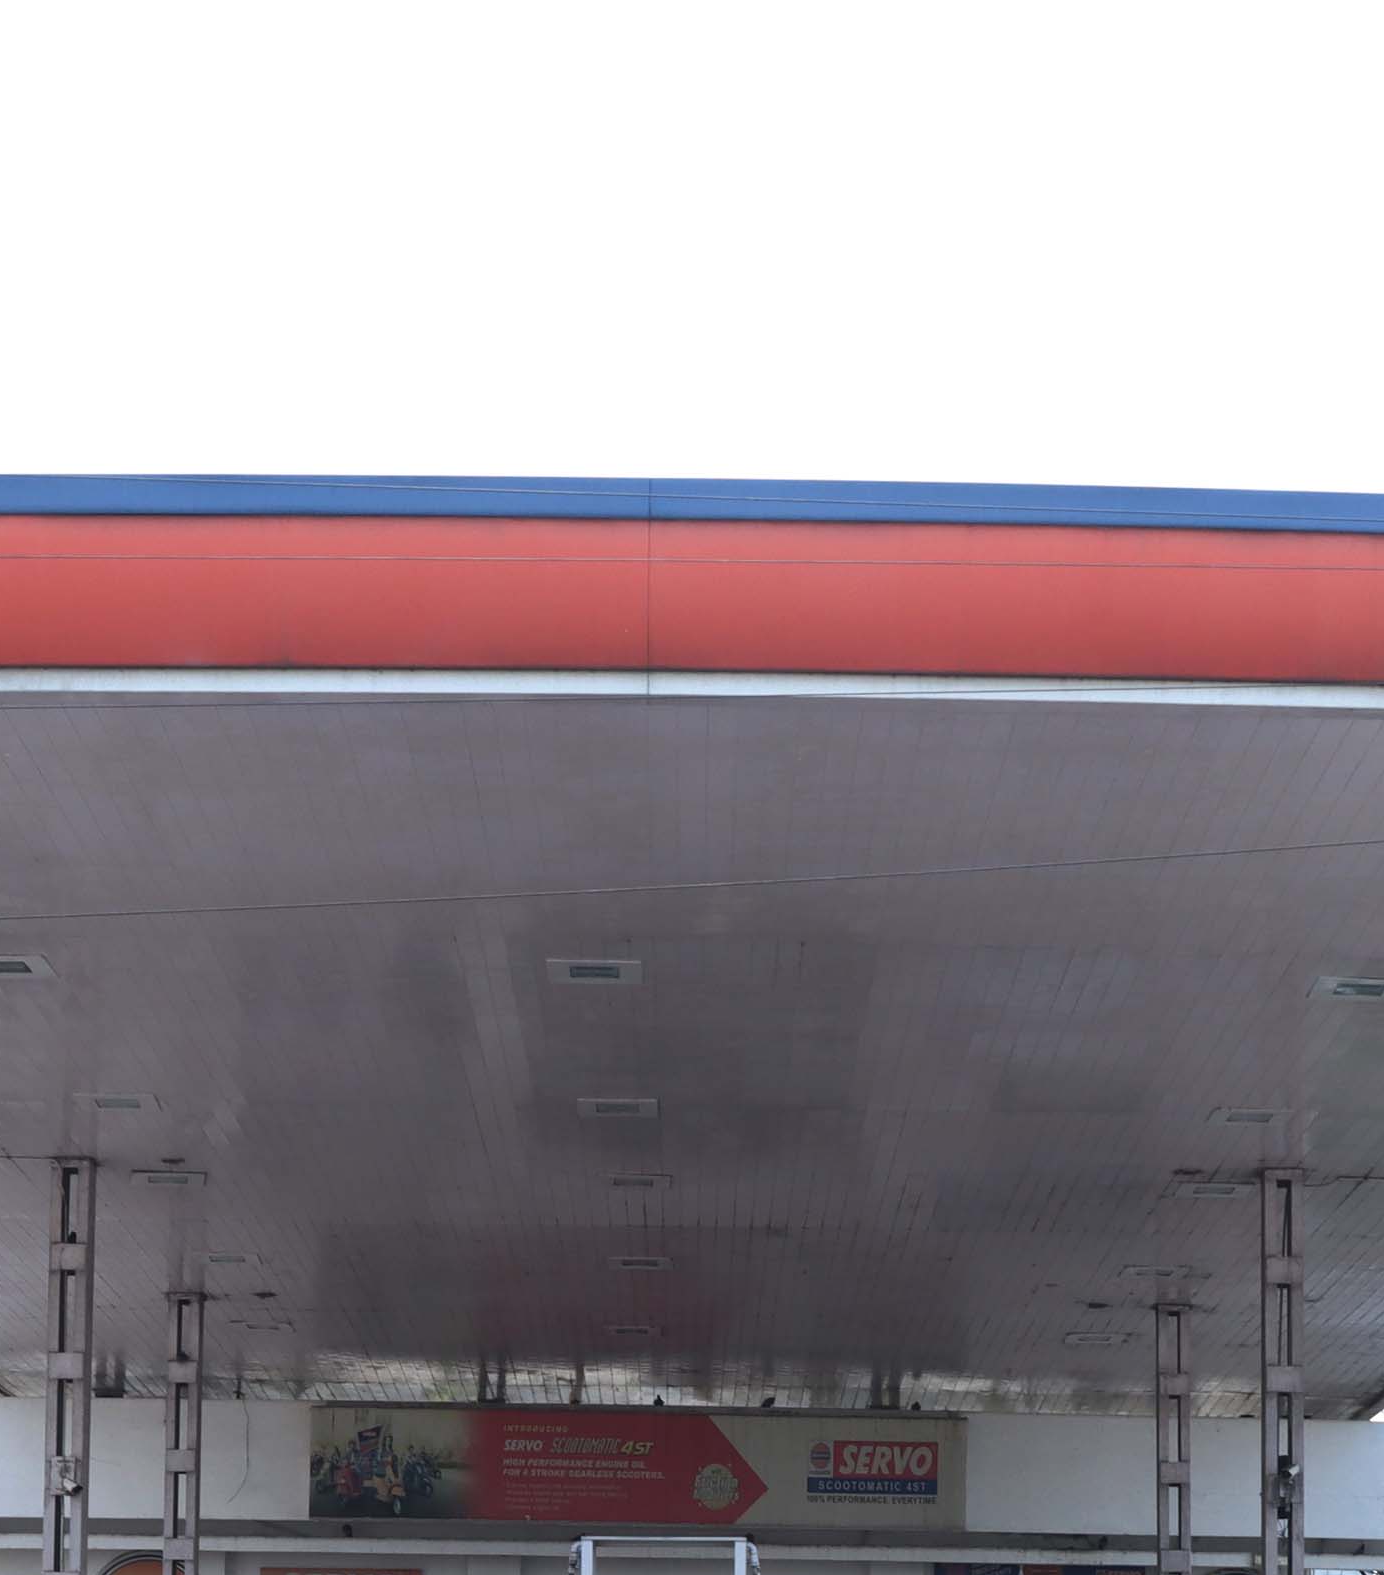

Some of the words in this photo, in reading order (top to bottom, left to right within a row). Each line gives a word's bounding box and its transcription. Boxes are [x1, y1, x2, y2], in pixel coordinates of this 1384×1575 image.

[503, 1424, 570, 1433] INTRODUCING
[503, 1439, 543, 1452] SERVO
[550, 1437, 621, 1454] SCOOTOMATIC
[620, 1440, 655, 1455] 4ST
[503, 1458, 526, 1467] HIGH
[527, 1459, 594, 1469] PERFORMANCE
[595, 1460, 629, 1469] ENGINE
[838, 1445, 934, 1476] SERVO
[503, 1468, 521, 1477] FOR
[530, 1469, 566, 1478] STROKE
[568, 1470, 615, 1479] GEARLESS
[818, 1480, 901, 1492] SCOOTOMATIC
[905, 1481, 927, 1492] 4ST
[827, 1496, 890, 1504] PERFORMANCE
[892, 1496, 938, 1505] EVERYTIME
